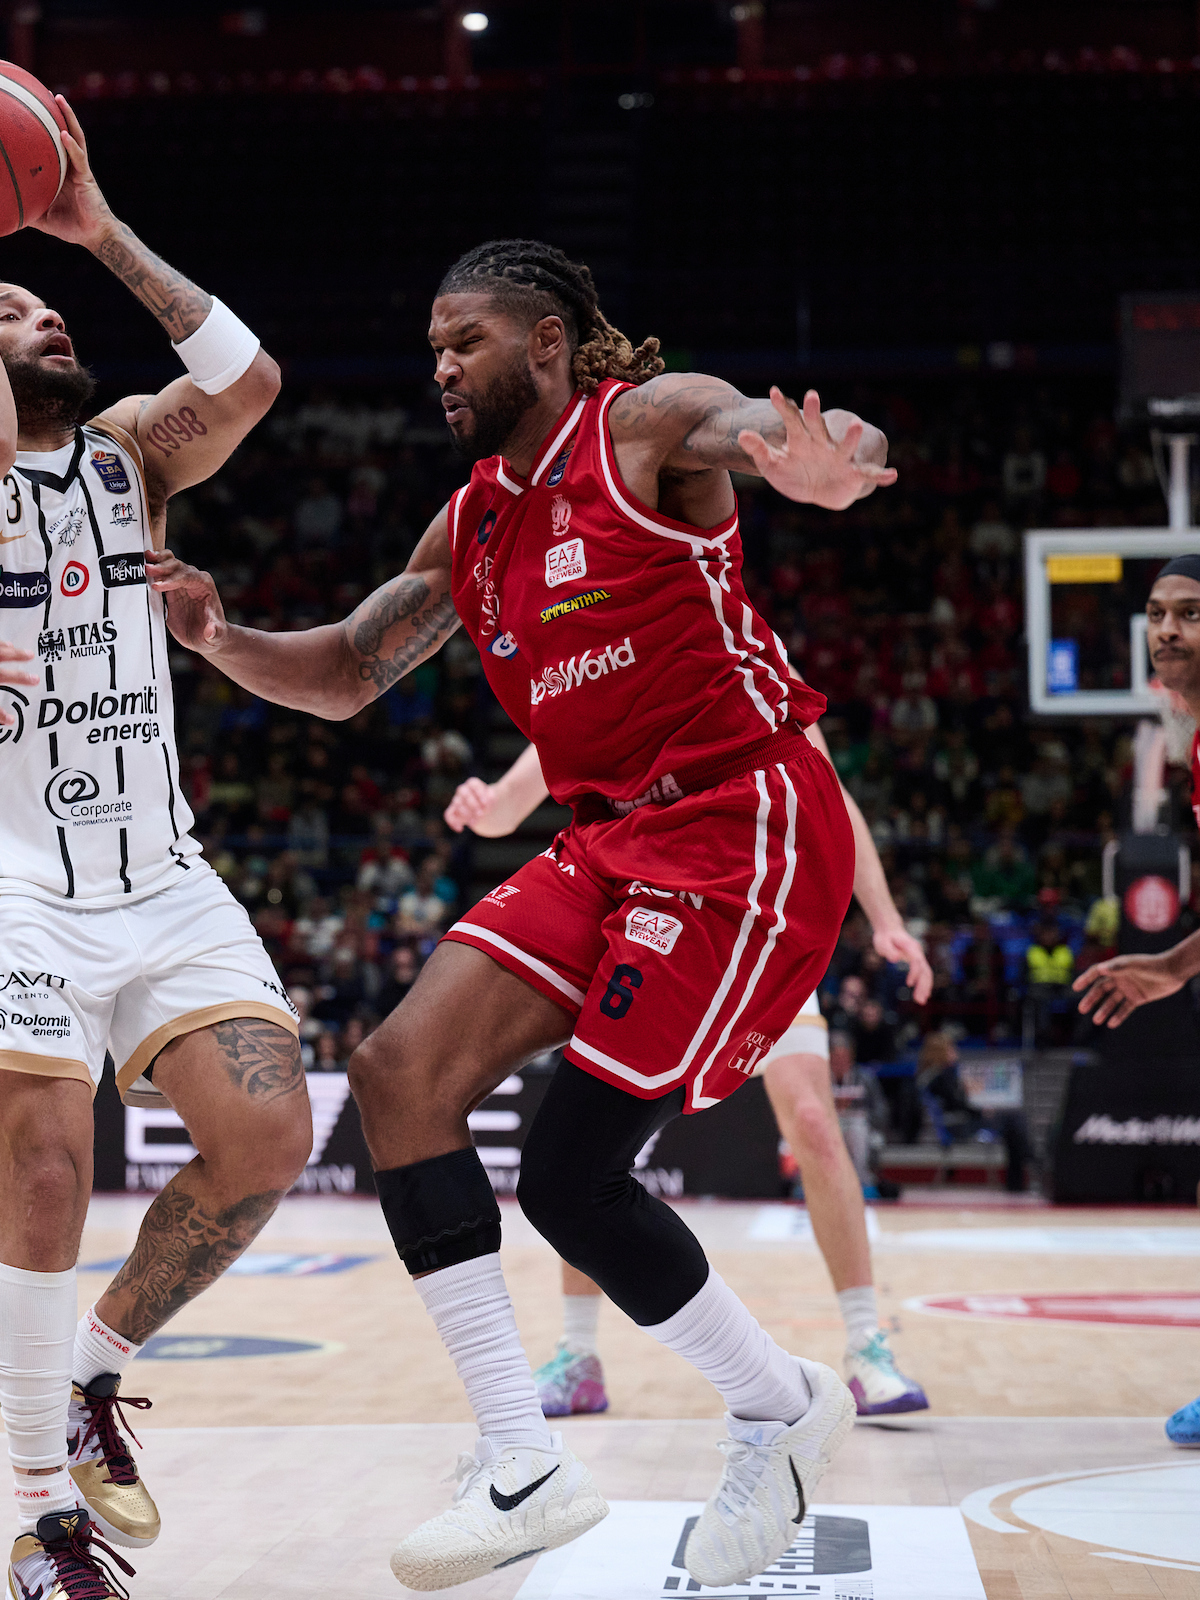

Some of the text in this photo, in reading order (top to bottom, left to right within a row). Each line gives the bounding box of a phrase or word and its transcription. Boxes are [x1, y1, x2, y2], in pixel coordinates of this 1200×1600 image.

[147, 406, 207, 457] 1998
[100, 465, 123, 475] LBA
[3, 474, 22, 524] 3
[548, 542, 579, 571] EA7
[106, 563, 146, 581] TRENTIN
[548, 566, 583, 583] EYEWEAR
[540, 589, 612, 623] SIMMENTHAL
[68, 620, 118, 647] ITAS
[70, 645, 107, 658] MUTUA
[37, 686, 158, 729] Dolomiti
[70, 800, 132, 817] Corporate
[73, 818, 108, 827] INFORMATICA
[631, 911, 677, 935] EA7
[629, 929, 667, 950] EYEWEAR
[600, 963, 644, 1020] 6
[11, 1013, 71, 1027] Dolomiti
[31, 1028, 71, 1038] energia
